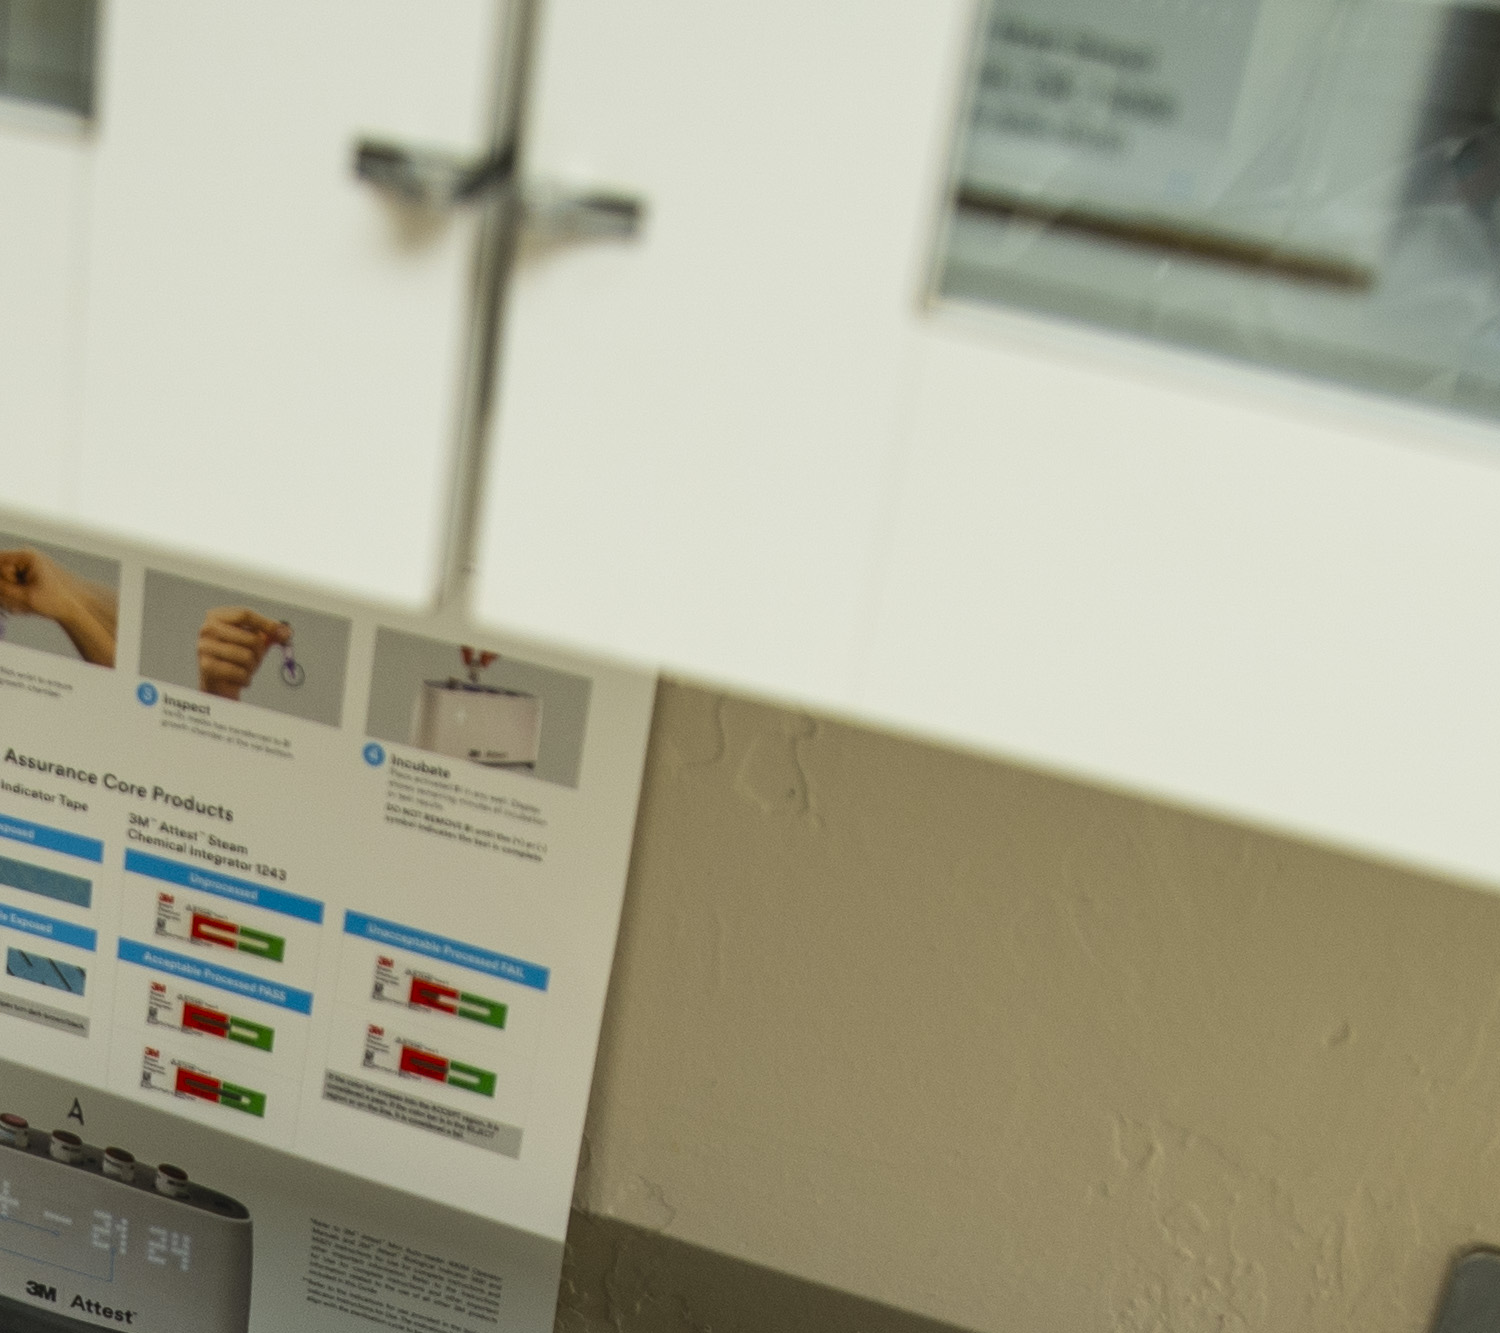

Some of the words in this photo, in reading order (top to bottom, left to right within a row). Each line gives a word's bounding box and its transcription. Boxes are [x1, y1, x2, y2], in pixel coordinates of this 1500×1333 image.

[164, 693, 211, 715] Inspect
[392, 755, 450, 778] Incubate
[0, 780, 55, 802] Indicator
[59, 794, 89, 812] Tape
[4, 749, 98, 786] Assurance
[104, 773, 147, 798] Core
[152, 786, 234, 821] Products
[128, 829, 186, 854] Chemical
[189, 843, 252, 871] Integrator
[257, 863, 287, 881] 1243
[209, 834, 248, 855] Steam
[26, 1280, 56, 1302] 3M
